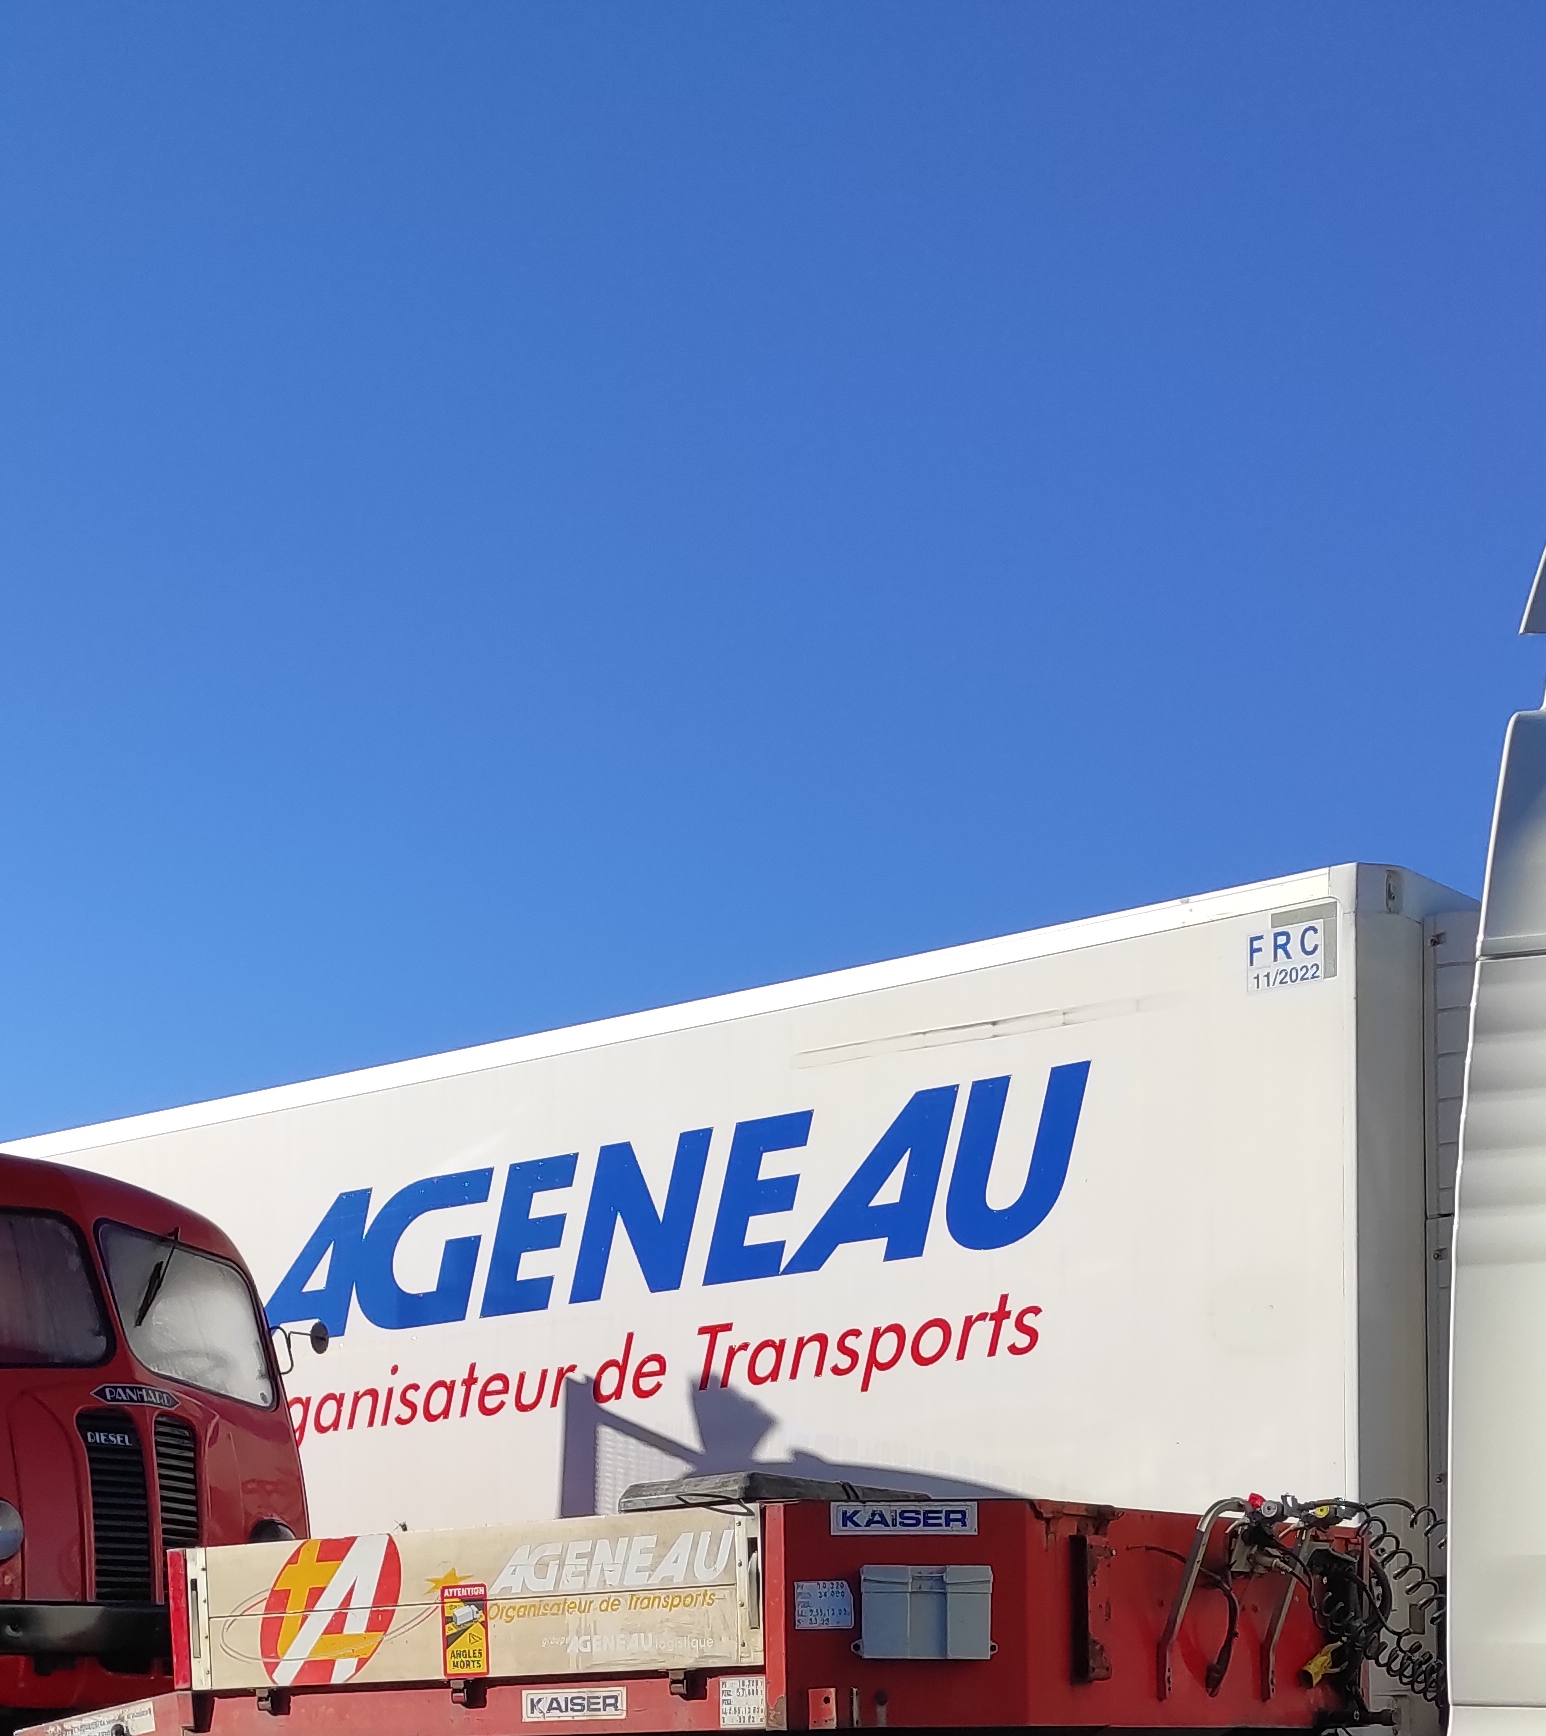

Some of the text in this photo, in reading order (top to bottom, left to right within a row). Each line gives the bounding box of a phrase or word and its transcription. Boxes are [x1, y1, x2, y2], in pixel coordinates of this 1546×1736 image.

[1249, 925, 1319, 967] FRC
[1253, 963, 1321, 990] 11/2022
[265, 1059, 1091, 1339] AGENEAU
[285, 1293, 1043, 1446] ganisateur de Transports
[104, 1387, 173, 1407] PANHARD
[86, 1431, 133, 1447] DIESEL
[841, 1508, 968, 1528] KAISER
[489, 1529, 735, 1595] AGENEAU
[443, 1586, 485, 1597] ATTENTION
[487, 1589, 717, 1624] Organisateur de Transports
[566, 1632, 653, 1654] AGENEAU
[450, 1649, 483, 1660] ANGLES
[452, 1659, 482, 1670] MORTS
[529, 1694, 620, 1715] KAISER
